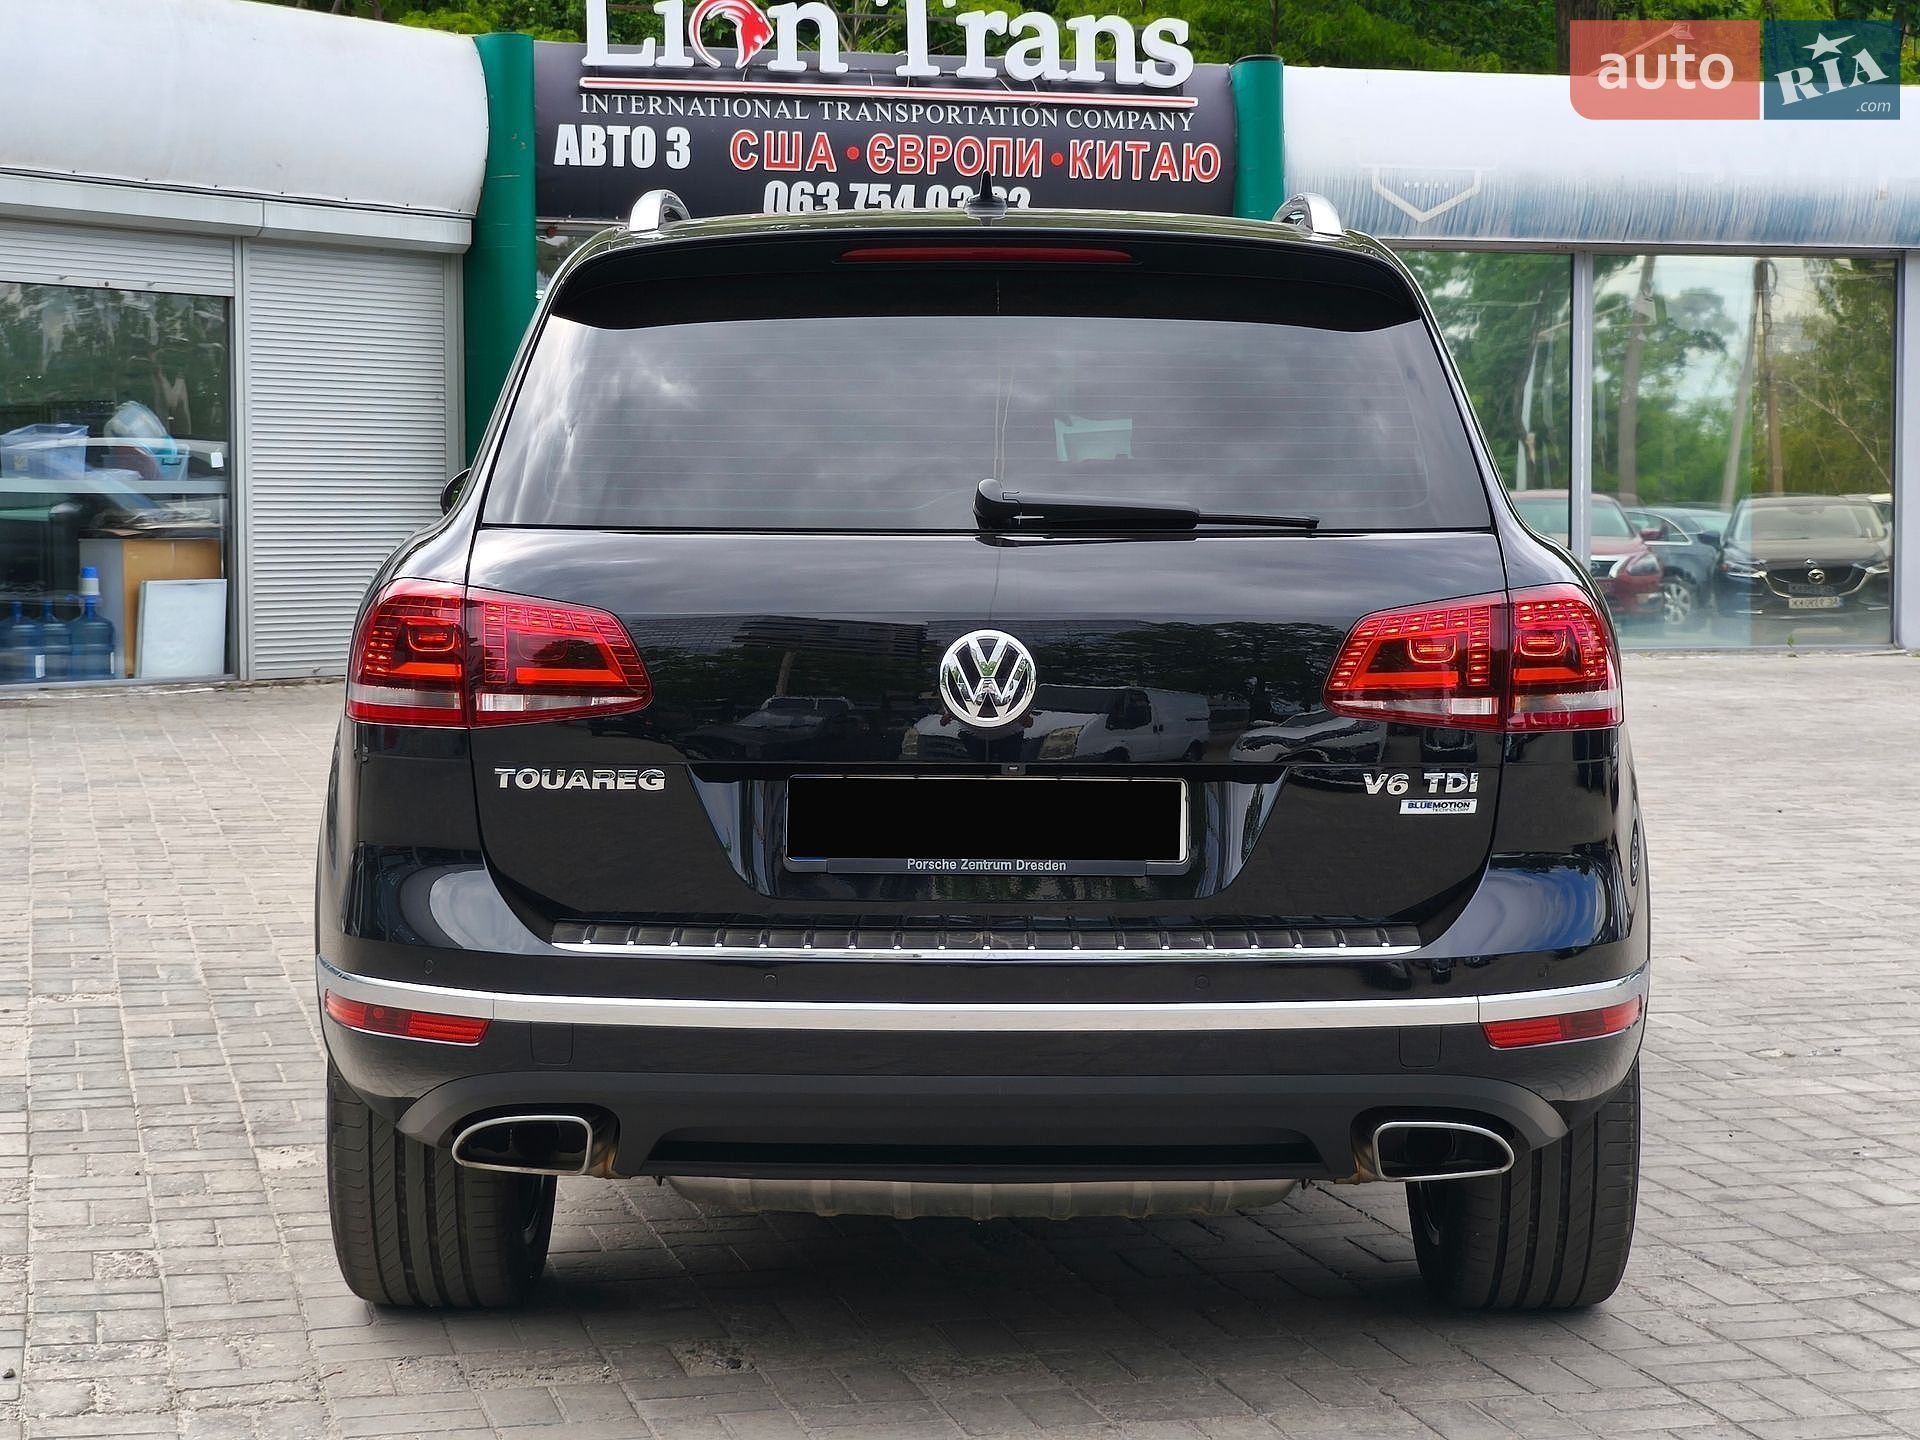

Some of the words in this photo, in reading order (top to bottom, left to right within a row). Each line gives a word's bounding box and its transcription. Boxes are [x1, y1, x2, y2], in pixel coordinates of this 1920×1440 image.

[876, 0, 1194, 89] Trans
[580, 93, 811, 121] INTERNATIONAL
[818, 101, 1058, 128] TRANSPORTATION
[1065, 108, 1195, 132] COMPANY
[553, 124, 656, 169] АВТО
[729, 129, 838, 173] США
[866, 133, 1043, 178] ЄВРОПИ
[1068, 139, 1222, 184] КИТАЮ
[763, 180, 840, 213] 063
[494, 767, 666, 791] TOUAREG
[1362, 772, 1410, 796] V6
[1407, 801, 1471, 809] BLUEMOTION
[907, 858, 957, 870] Porsche
[960, 858, 1012, 870] Zentrum
[1015, 859, 1067, 871] Dresden
